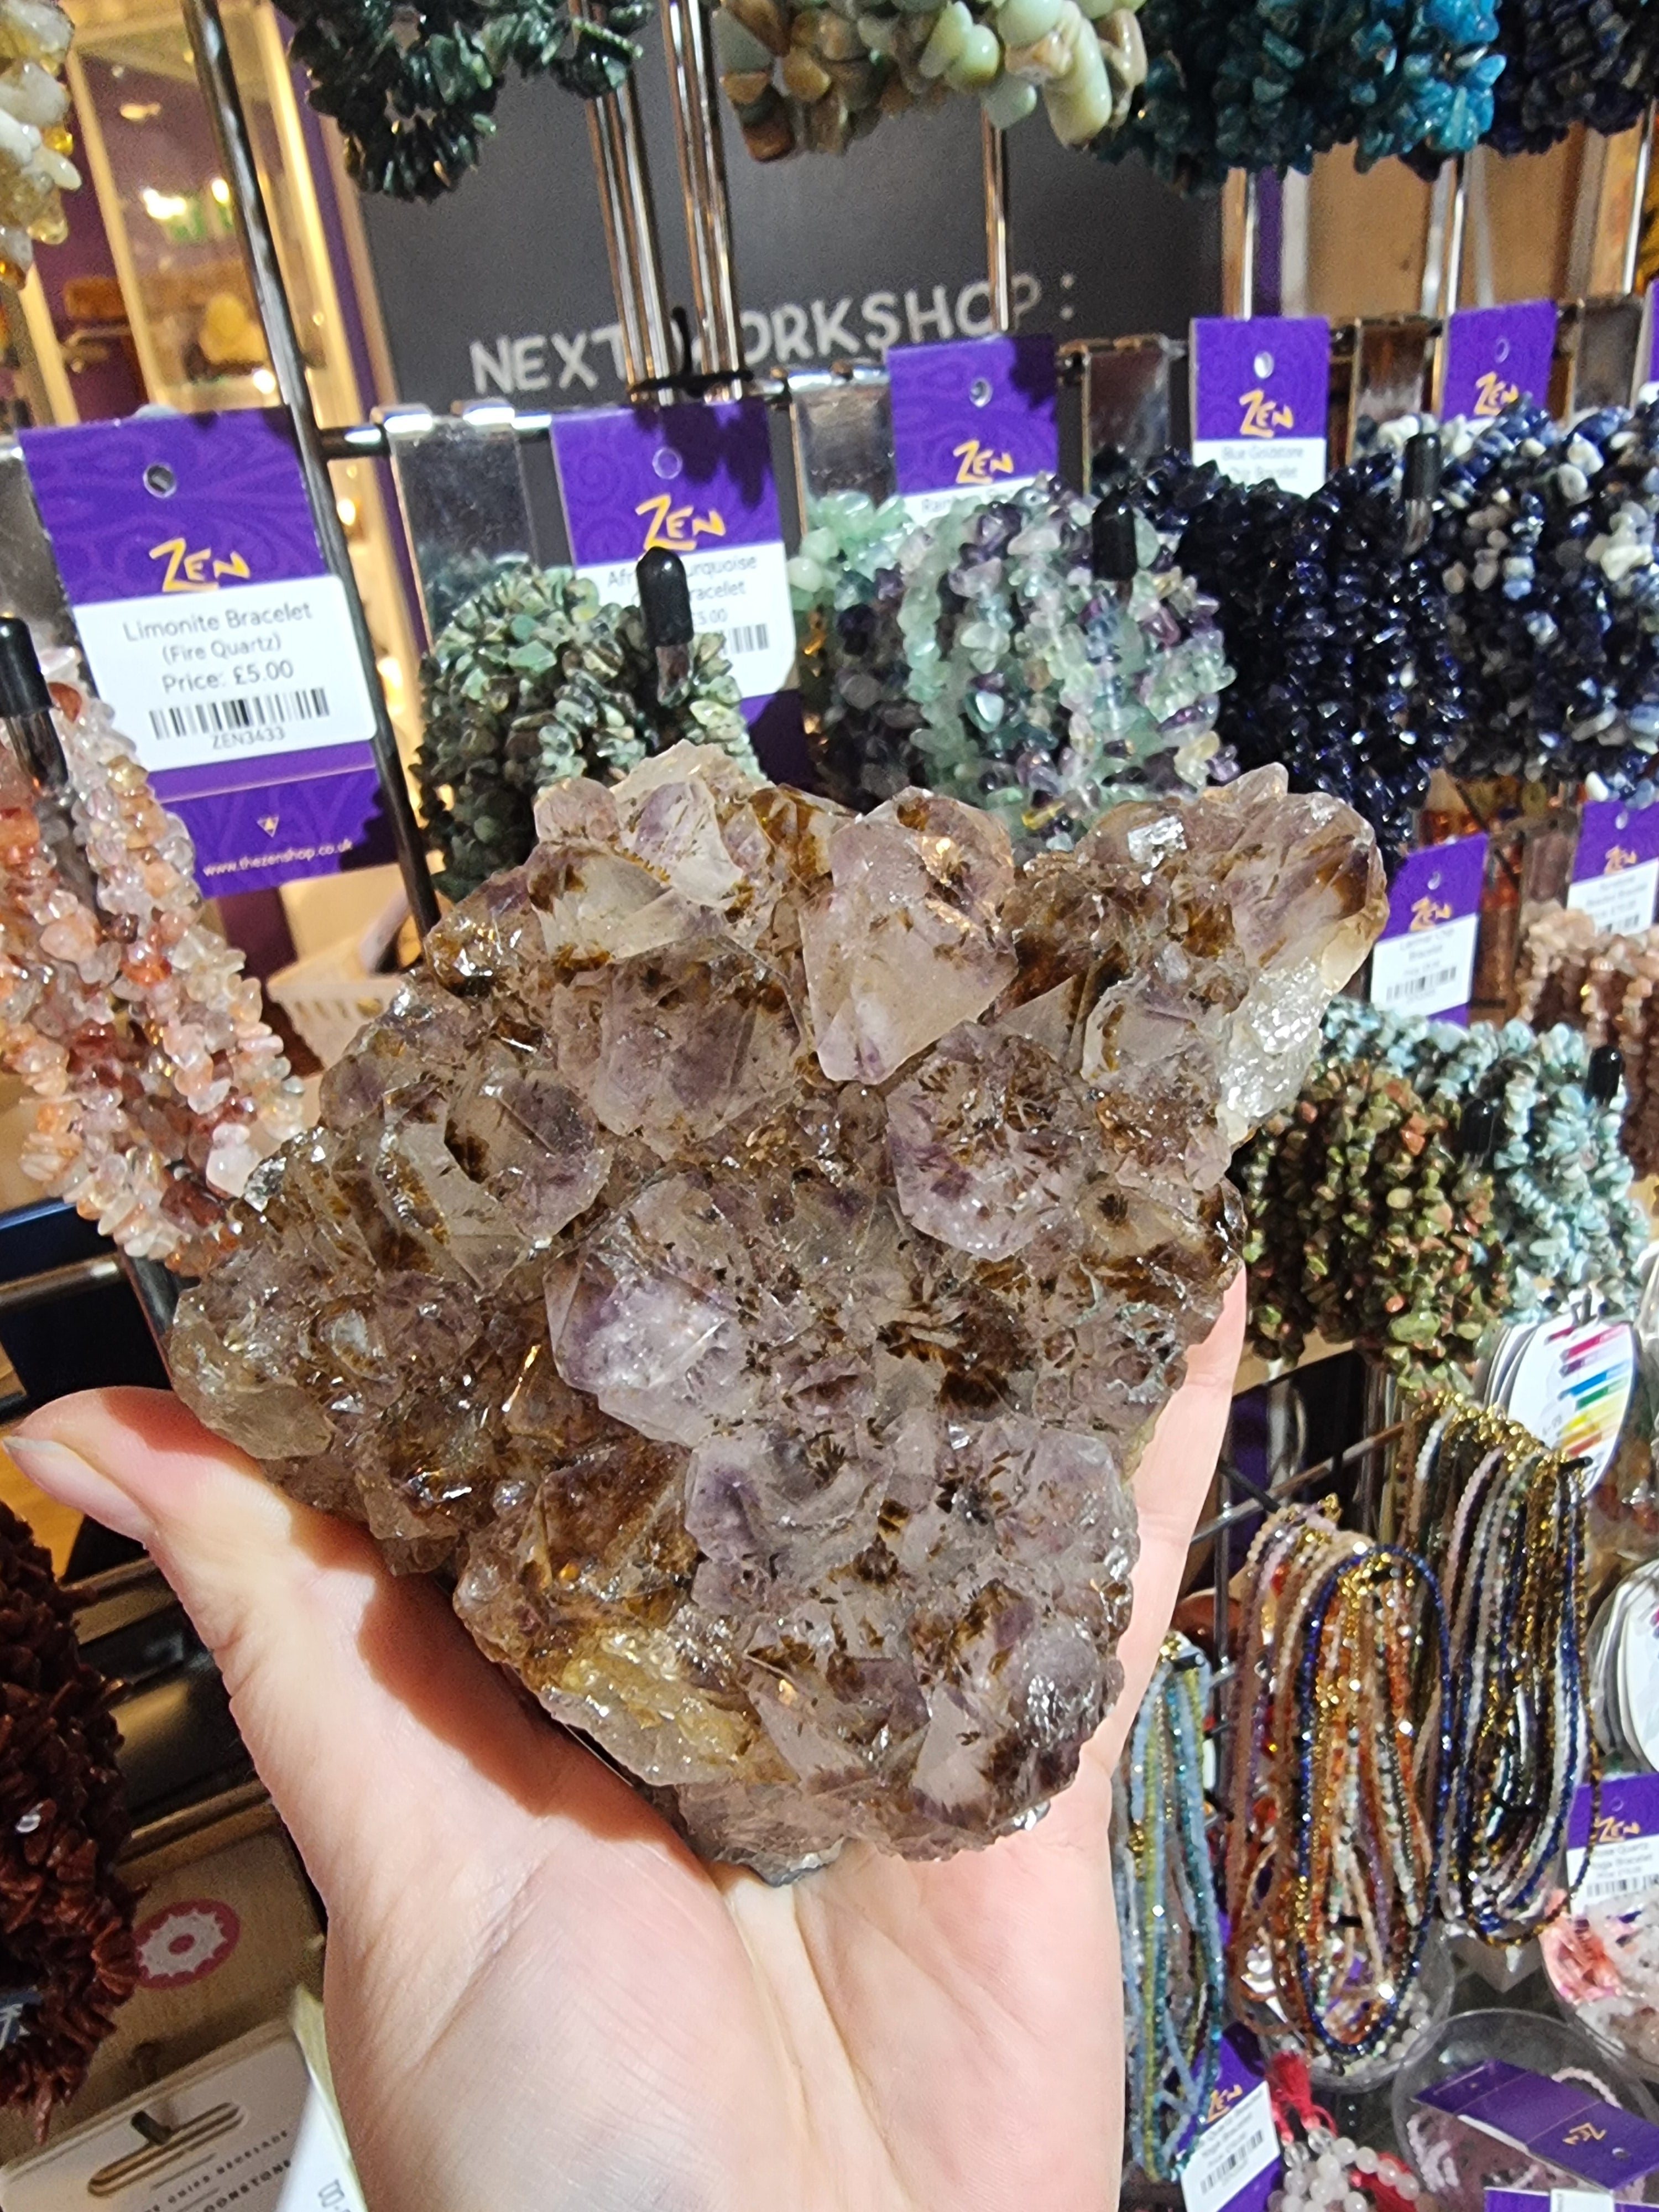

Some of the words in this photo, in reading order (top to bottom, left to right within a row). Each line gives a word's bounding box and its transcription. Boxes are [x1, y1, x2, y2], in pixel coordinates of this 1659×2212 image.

[469, 322, 628, 394] NEXT
[669, 272, 1076, 378] ORKSHOP:
[1239, 388, 1294, 438] ZEN
[953, 439, 1014, 485] ZEN
[635, 494, 726, 551] ZEN
[149, 538, 251, 593] ZEN
[689, 581, 747, 601] racelet
[122, 614, 220, 642] Limonite
[225, 602, 314, 629] Bracelet
[161, 645, 207, 665] (Fire
[210, 632, 282, 660] Quartz)
[161, 671, 225, 694] Price:
[232, 659, 294, 686] £5.00
[212, 725, 286, 750] ZEN3433
[203, 838, 353, 877] www.thezenshop.co.uk
[200, 2159, 291, 2212] OONSTONE
